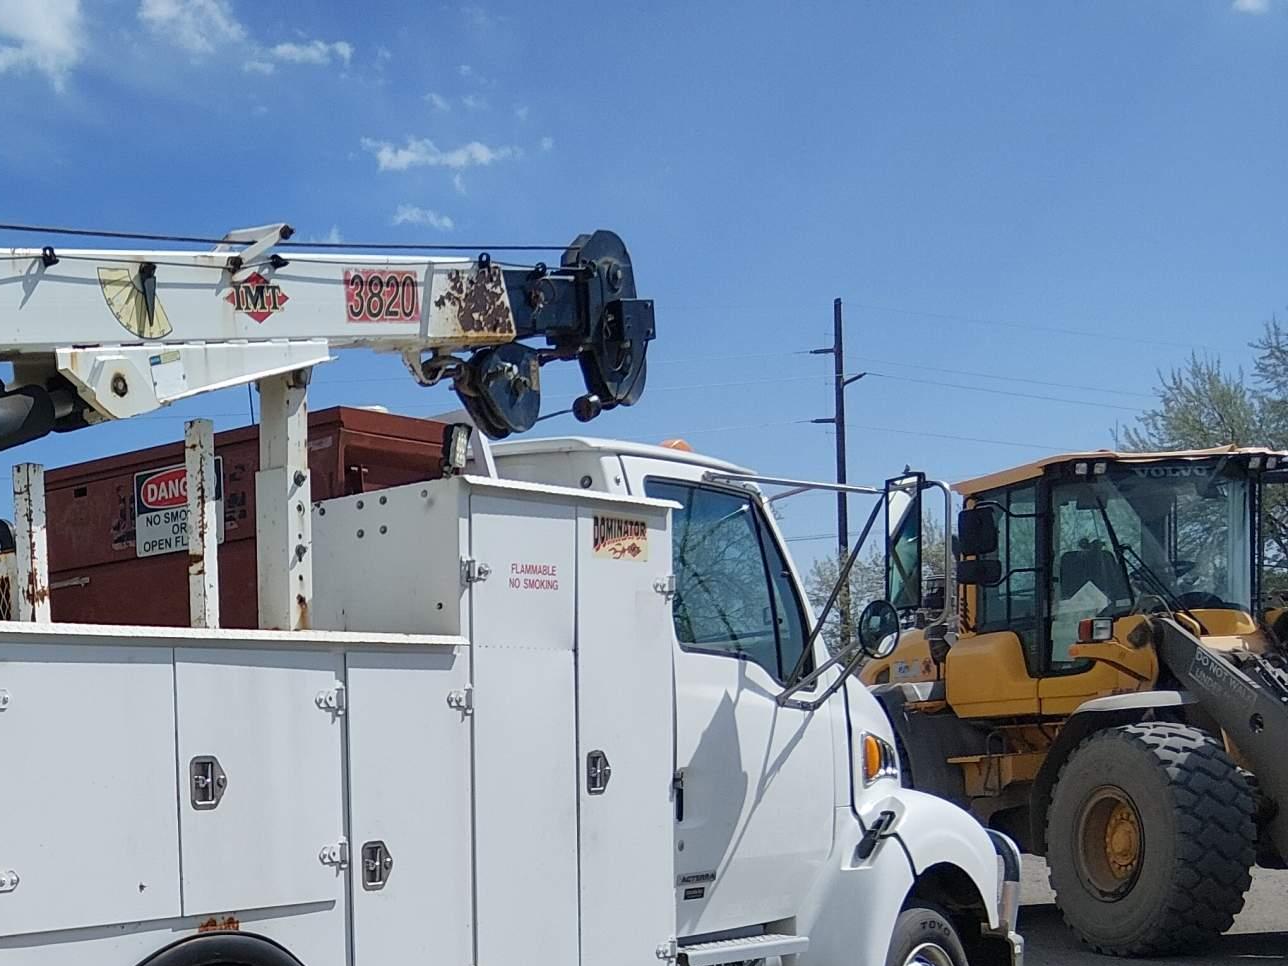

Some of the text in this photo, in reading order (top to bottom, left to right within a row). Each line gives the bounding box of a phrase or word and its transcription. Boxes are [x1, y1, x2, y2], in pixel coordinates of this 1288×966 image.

[233, 284, 282, 313] IMT
[348, 273, 418, 320] 3820
[1131, 466, 1210, 478] VOLVO
[147, 476, 188, 503] DANG
[146, 512, 161, 527] NO
[172, 522, 187, 535] OR
[593, 515, 648, 550] DOMINATOR
[144, 537, 172, 552] OPEN
[511, 563, 557, 576] FLAMMABLE
[509, 578, 559, 591] NO SMOKING
[1196, 650, 1209, 666] DO
[1209, 662, 1229, 681] NOT
[920, 920, 951, 937] TOYO
